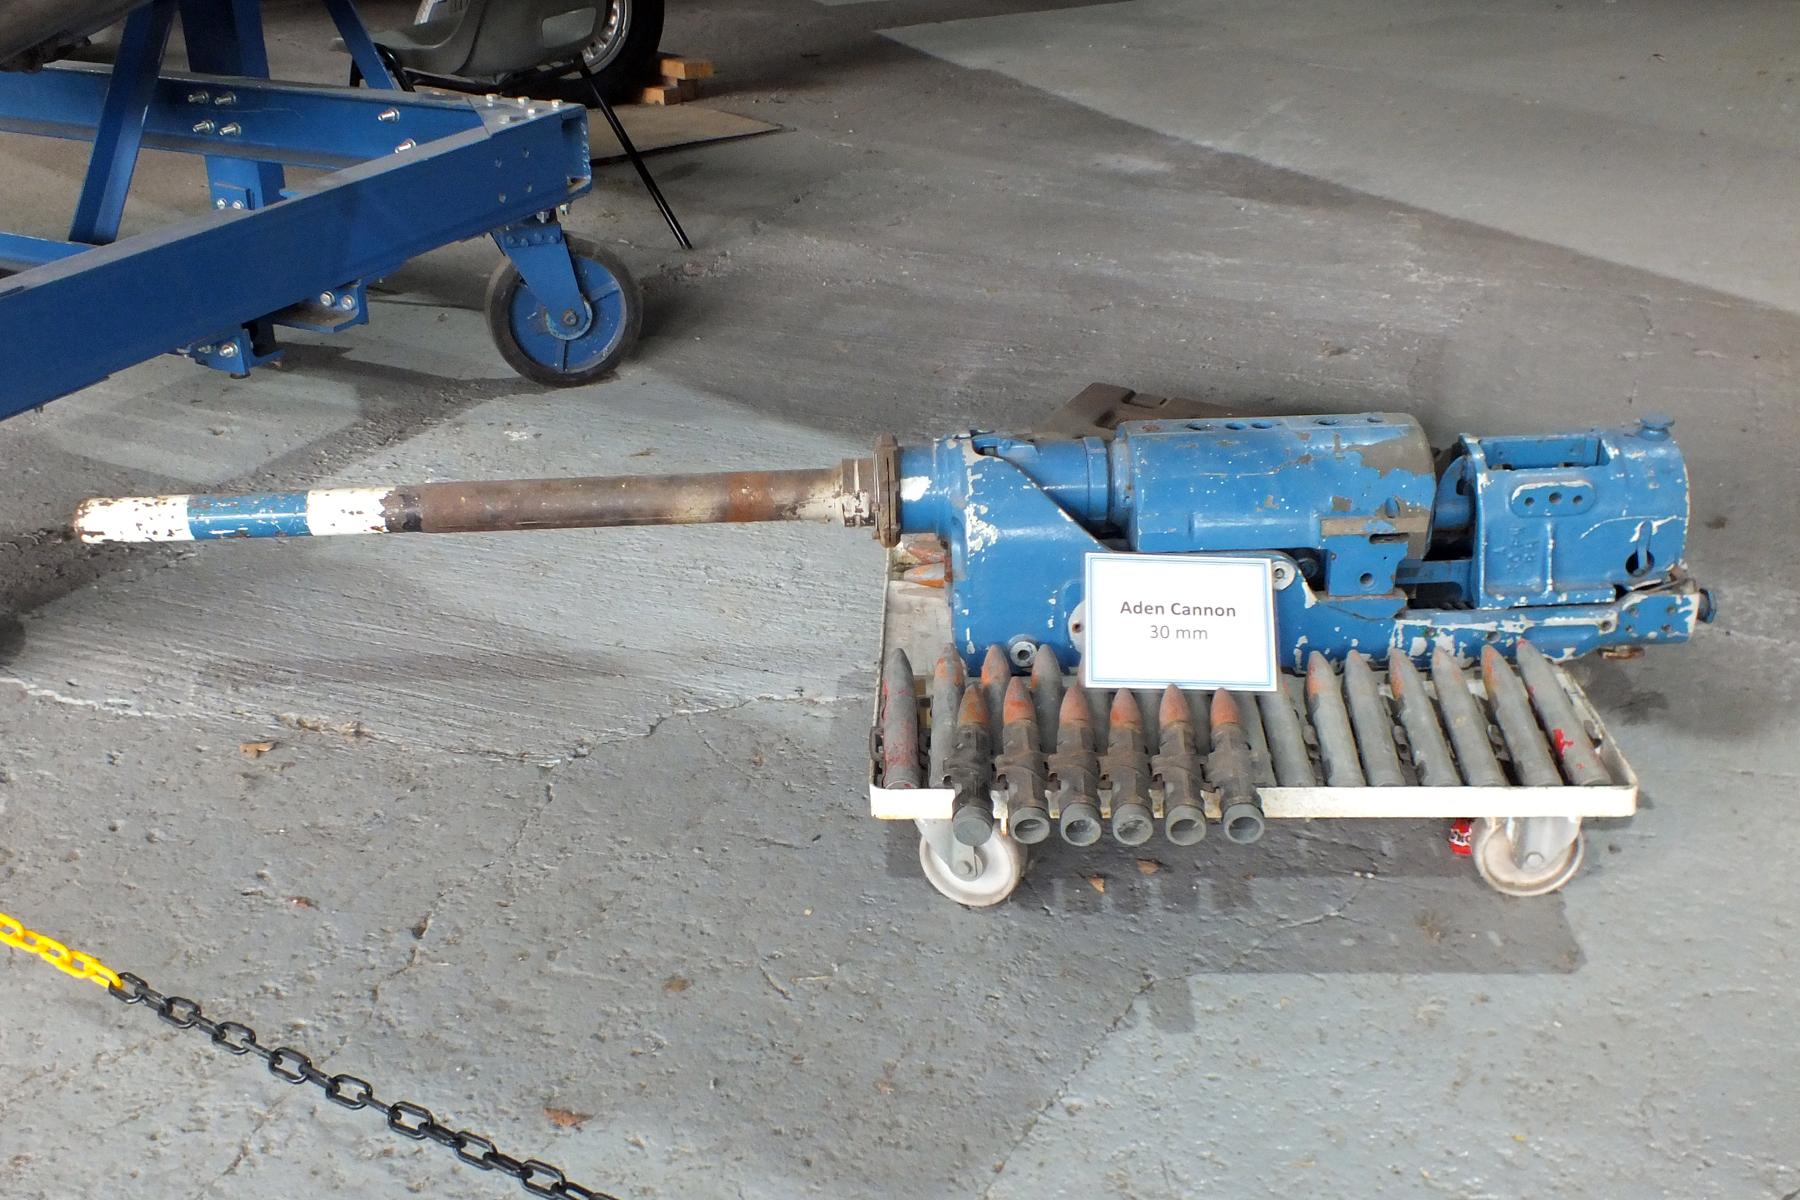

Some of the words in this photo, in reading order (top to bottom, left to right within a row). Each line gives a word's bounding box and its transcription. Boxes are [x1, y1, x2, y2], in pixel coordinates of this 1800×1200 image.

[1120, 601, 1164, 615] Aden
[1171, 602, 1236, 617] Cannon
[1150, 625, 1169, 639] 30
[1175, 628, 1208, 639] mm
